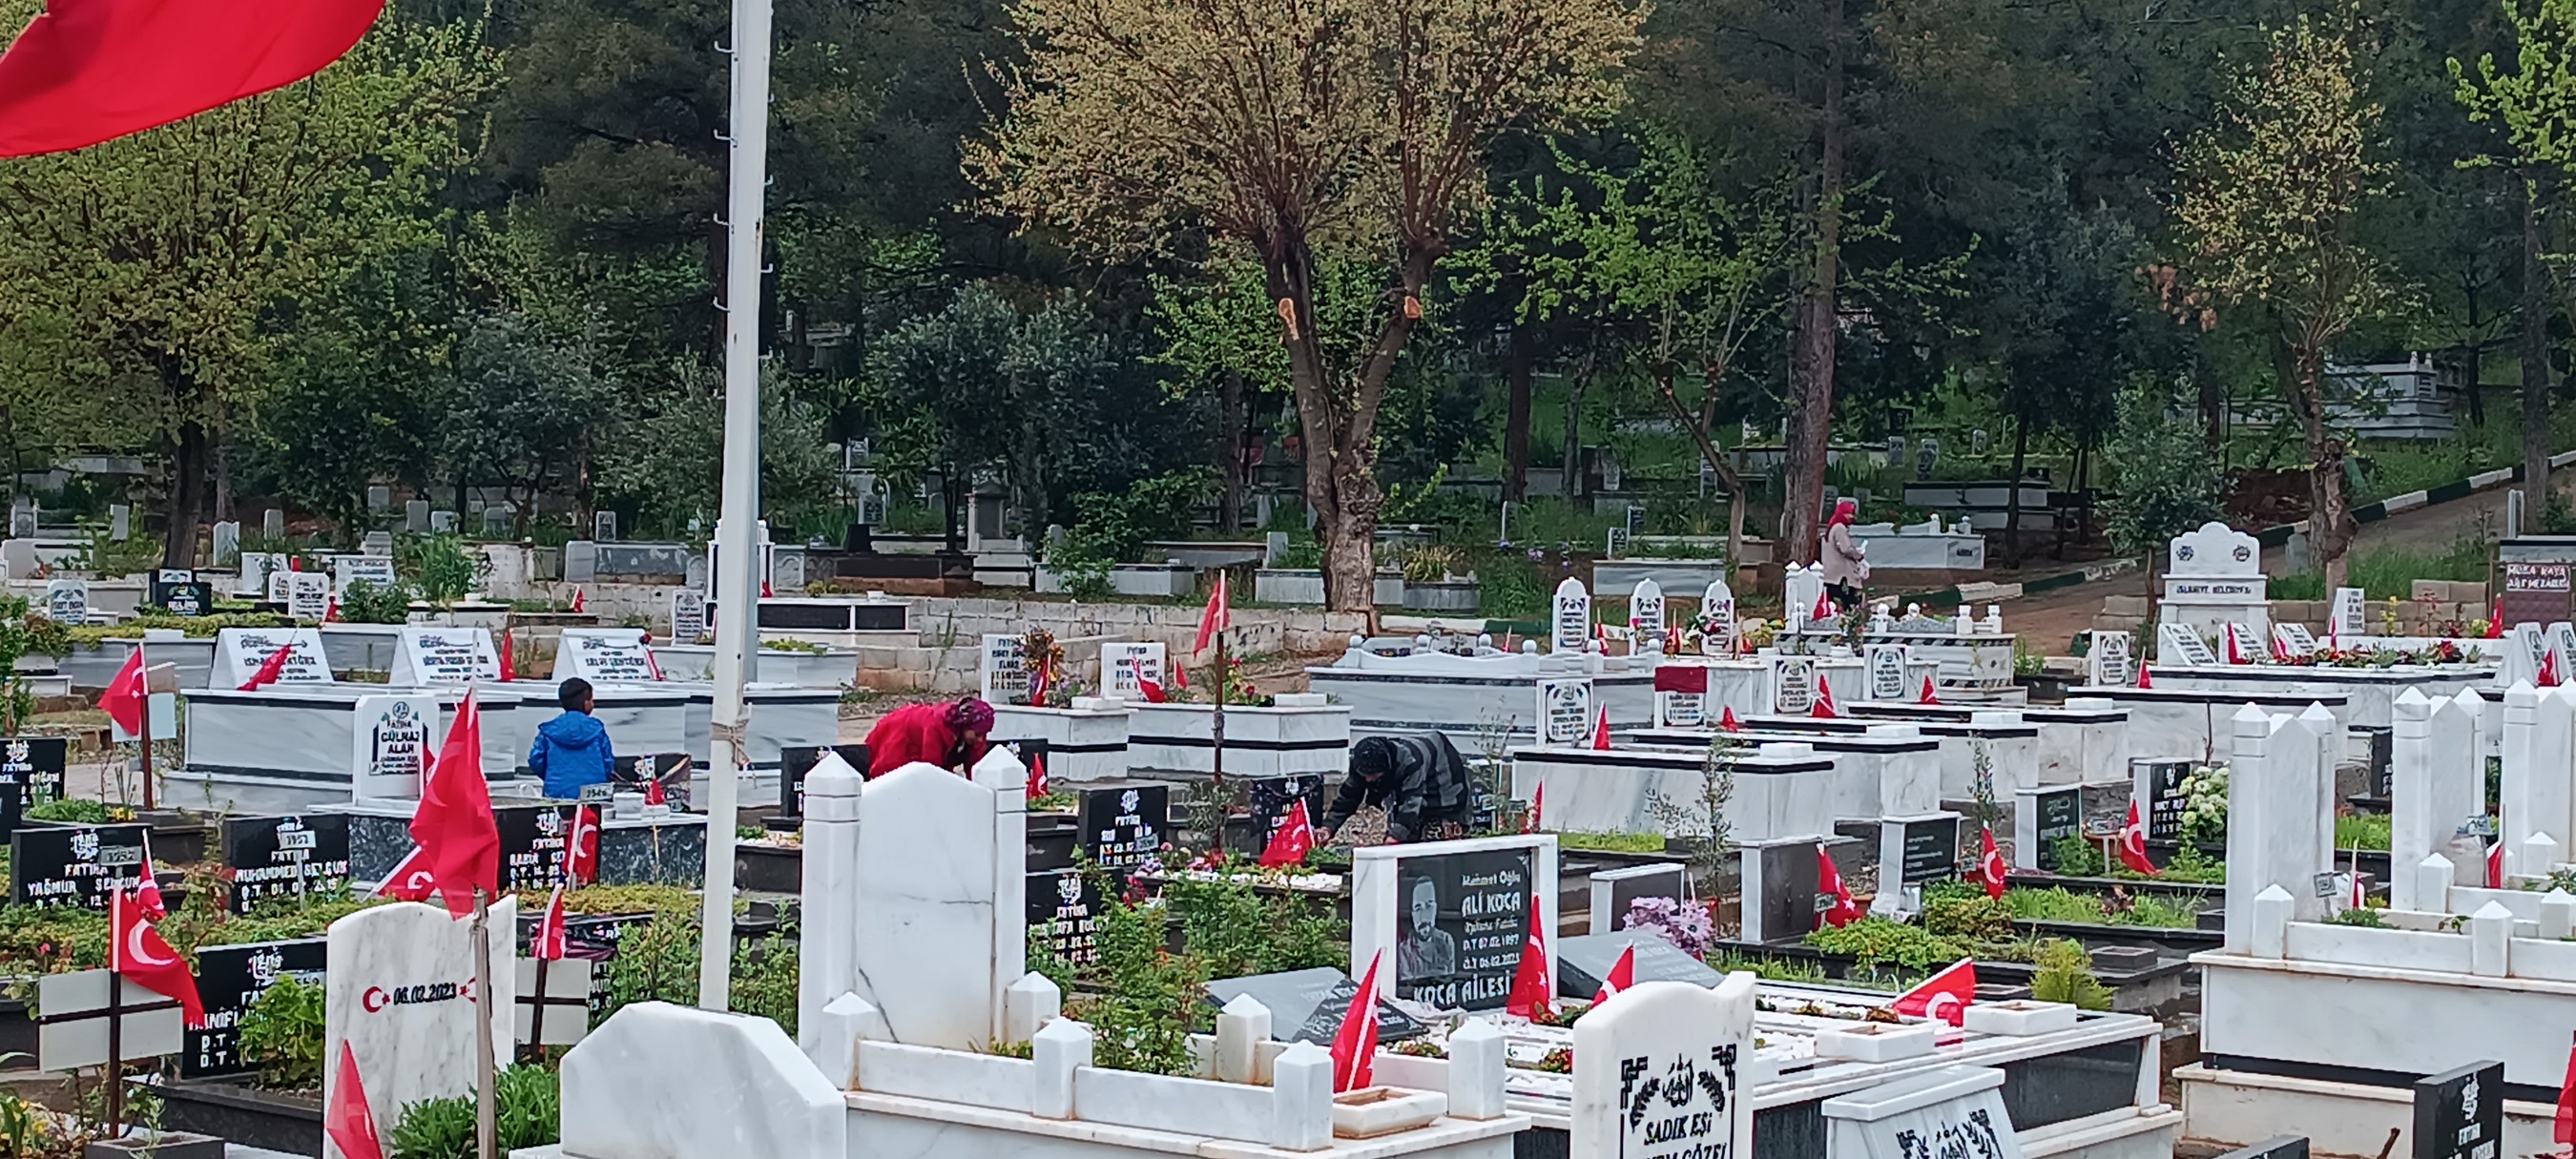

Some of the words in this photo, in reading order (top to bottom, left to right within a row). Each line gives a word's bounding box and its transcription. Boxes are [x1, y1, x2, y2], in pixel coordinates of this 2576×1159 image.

[1462, 889, 1483, 917] ALİ
[1486, 892, 1521, 913] KOCA
[393, 982, 457, 1005] 06.02.2023
[1414, 983, 1457, 1005] KOCA
[1462, 970, 1510, 1004] AİLESİ
[1644, 1115, 1689, 1146] SADIK
